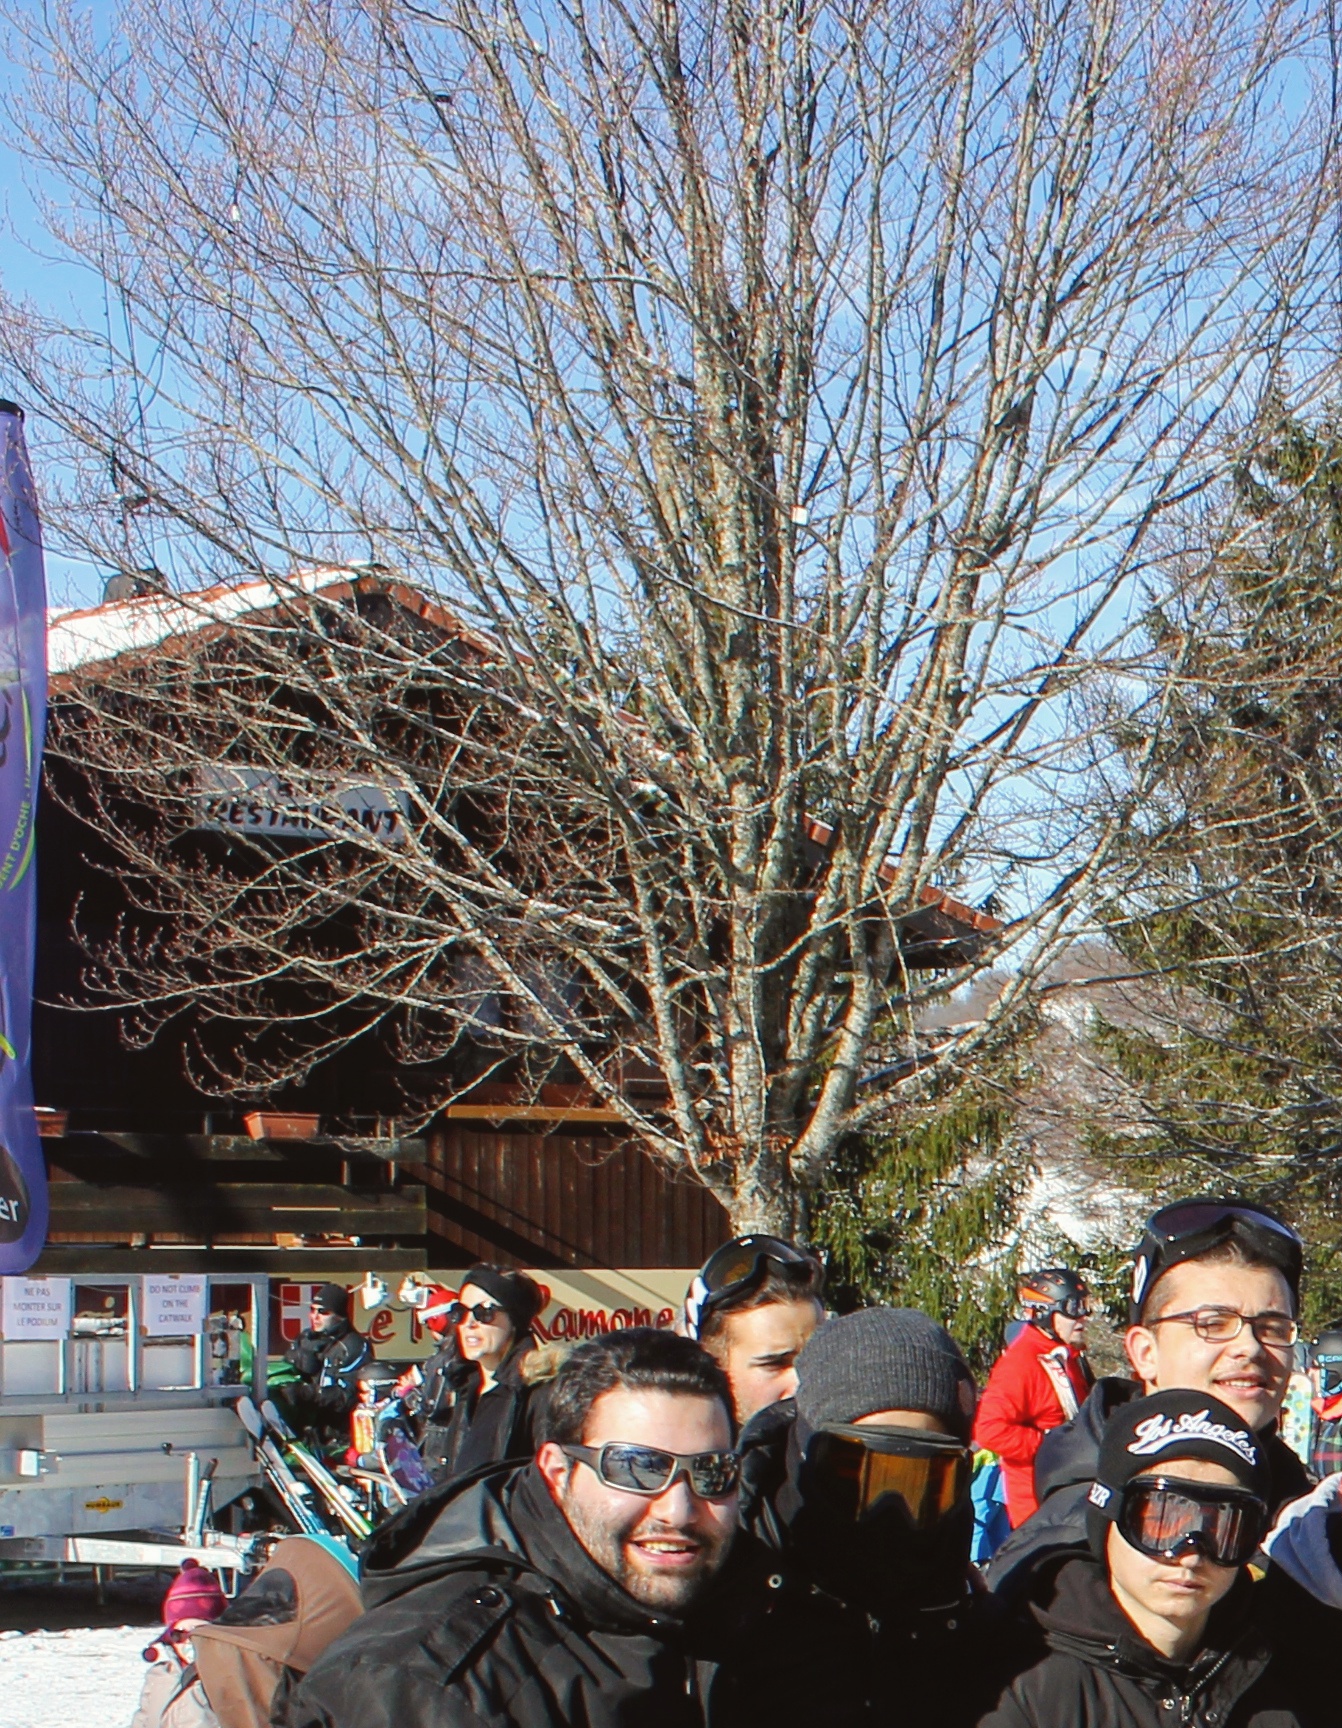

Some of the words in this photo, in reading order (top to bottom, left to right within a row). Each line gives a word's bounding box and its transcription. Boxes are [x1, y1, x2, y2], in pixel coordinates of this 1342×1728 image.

[24, 1287, 35, 1296] NE
[36, 1288, 50, 1296] PAS
[150, 1285, 161, 1293] DO
[162, 1285, 178, 1293] NOT
[13, 1302, 45, 1311] MONTER
[47, 1303, 62, 1311] SUR
[162, 1300, 173, 1308] ON
[17, 1317, 26, 1326] LE
[1128, 1413, 1174, 1454] Los
[1173, 1409, 1257, 1460] Angeles
